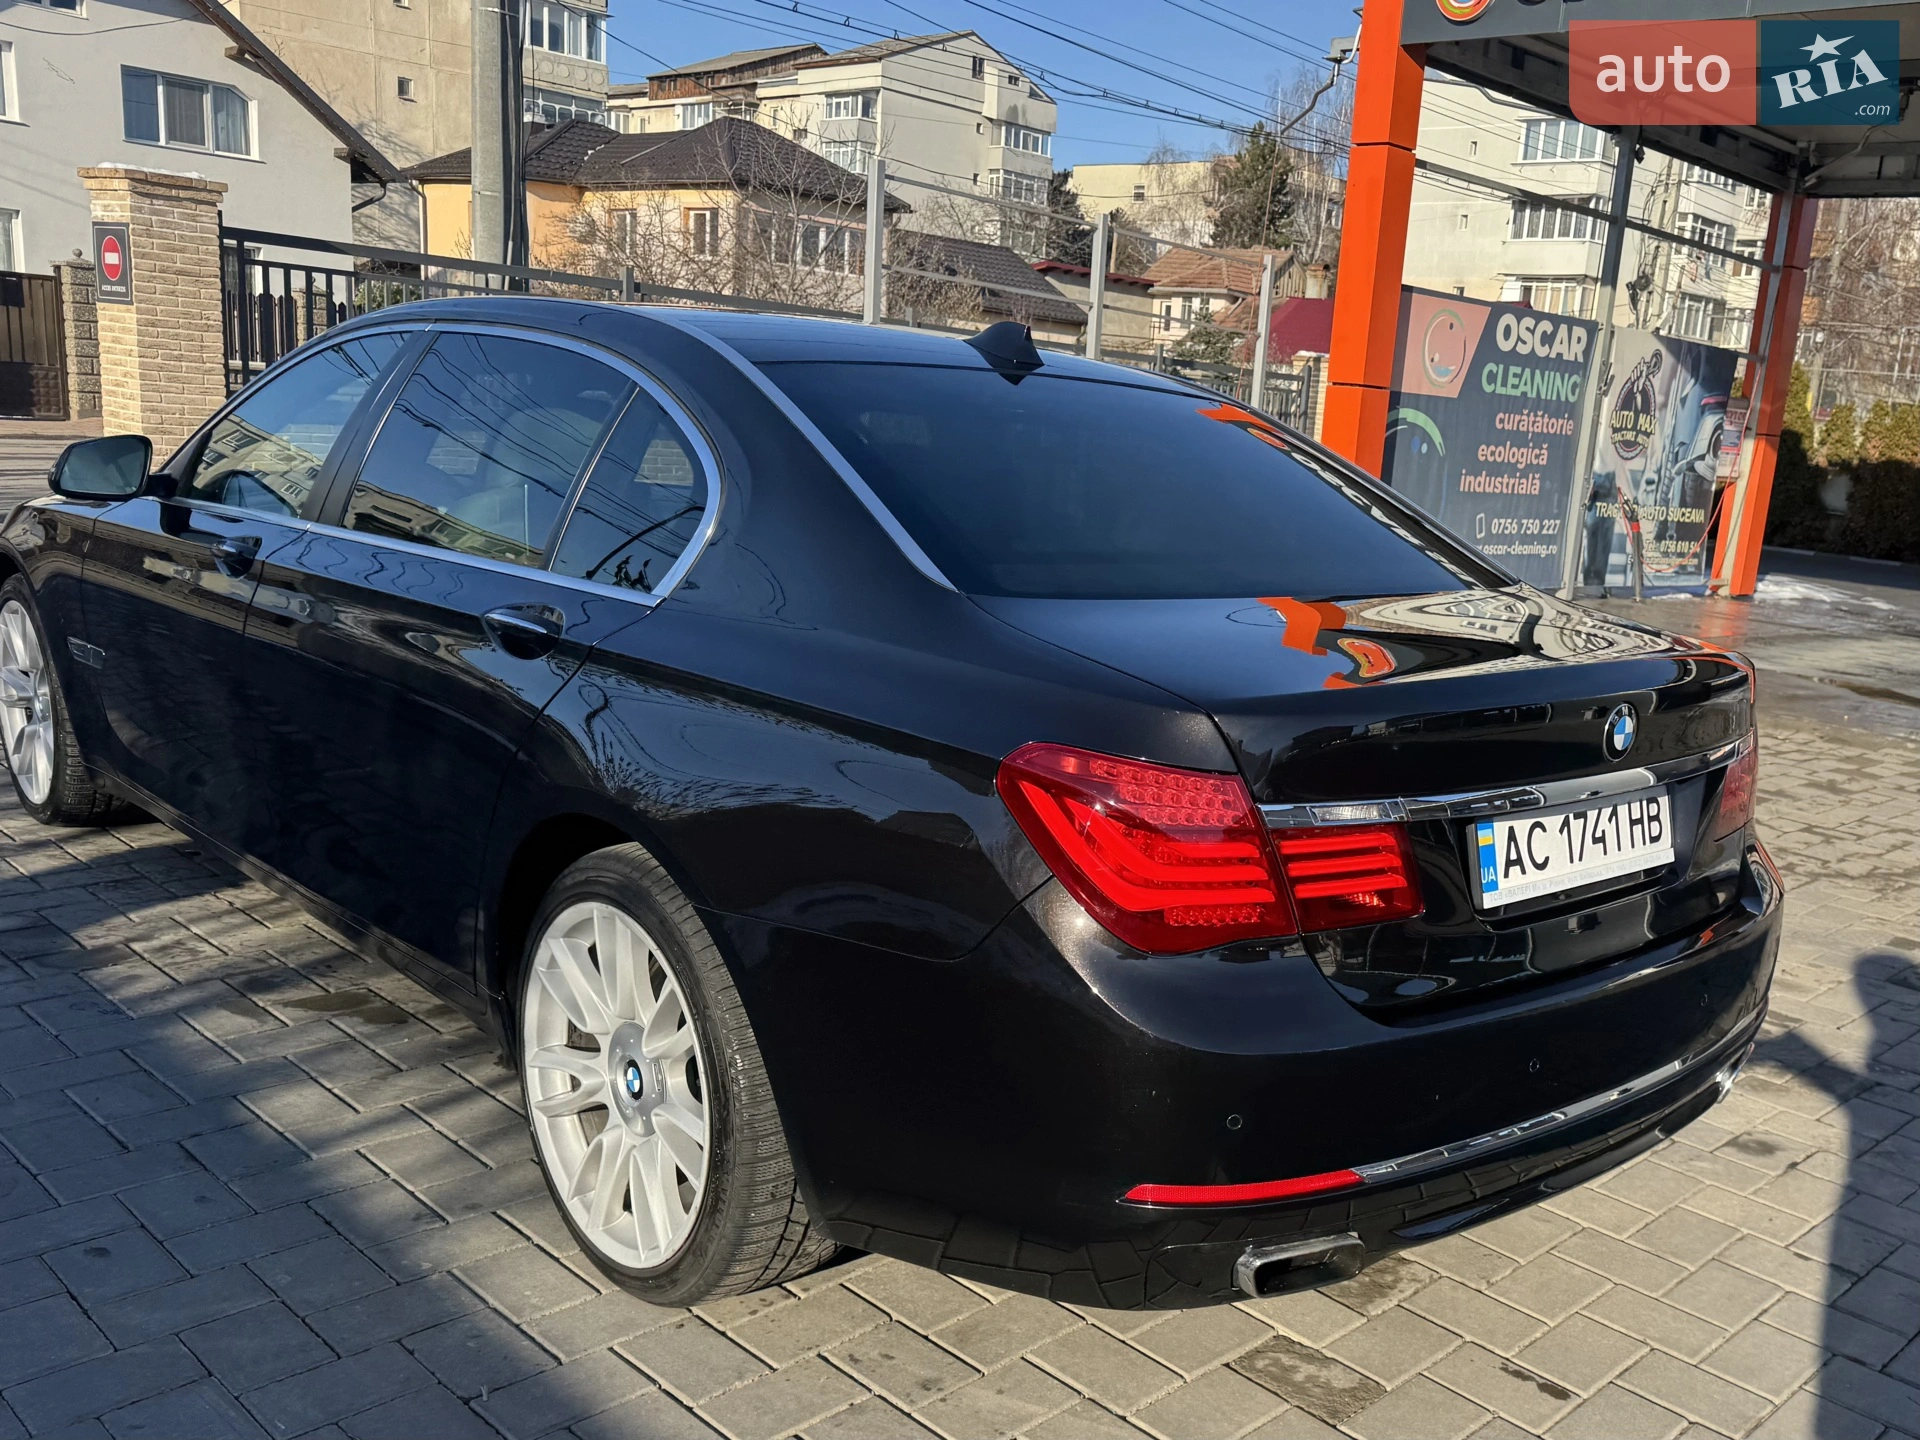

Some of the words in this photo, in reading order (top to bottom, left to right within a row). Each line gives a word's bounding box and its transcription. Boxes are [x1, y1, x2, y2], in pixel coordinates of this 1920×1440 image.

[1496, 313, 1587, 362] OSCAR
[1482, 362, 1581, 403] CLEANING
[1496, 409, 1574, 440] curățătorie
[1610, 410, 1635, 429] AUTO
[1636, 413, 1657, 434] MAX
[1478, 441, 1548, 469] ecologică
[1460, 469, 1540, 495] industrială
[1491, 518, 1518, 534] 0756
[1520, 519, 1540, 534] 750
[1541, 519, 1560, 534] 227
[1667, 507, 1705, 523] SUCEAVA
[1503, 821, 1550, 878] AC
[1558, 803, 1622, 864] 1741
[1628, 796, 1663, 849] HB
[1481, 866, 1496, 884] UA
